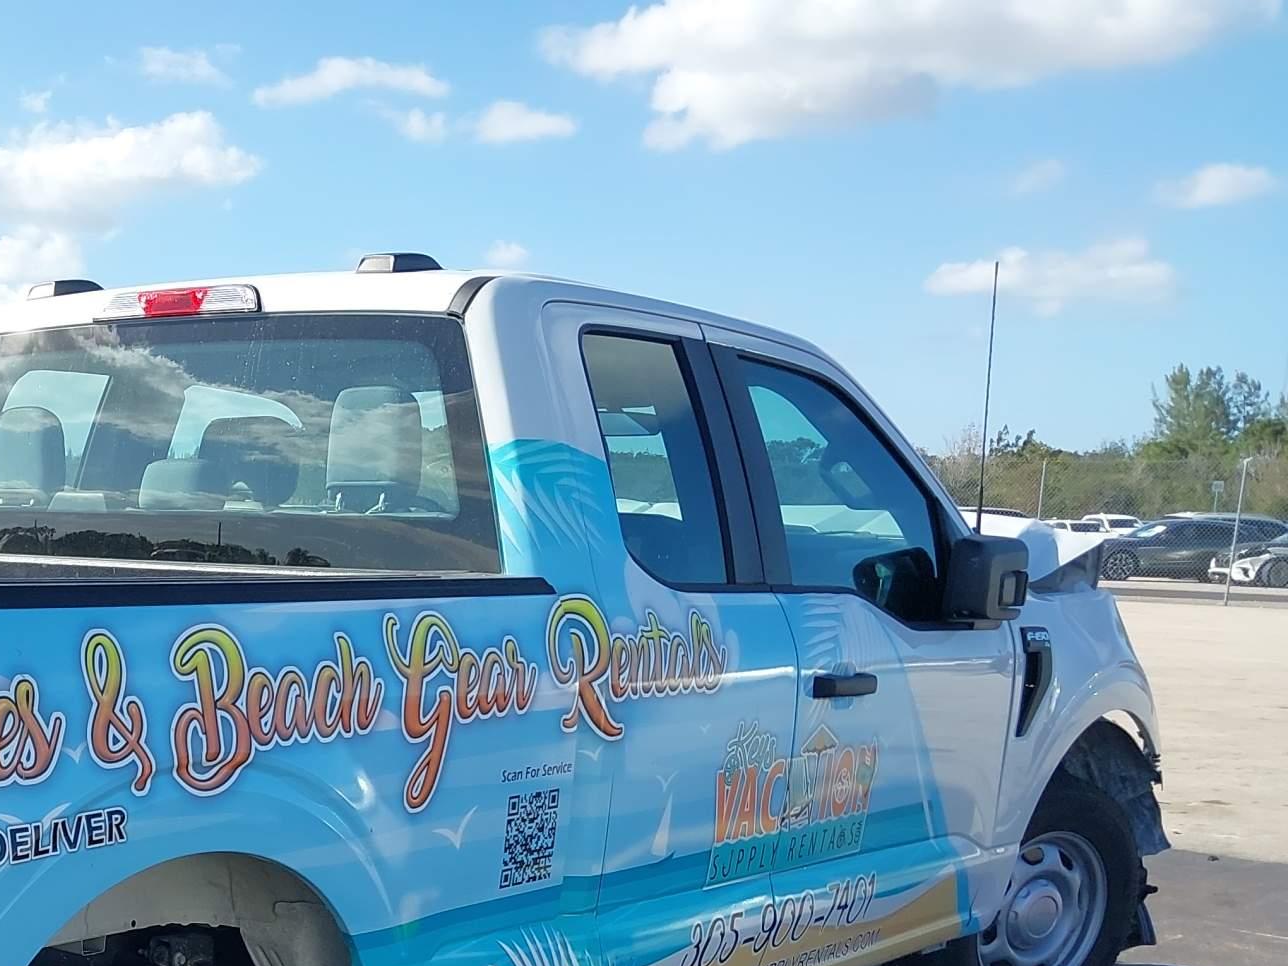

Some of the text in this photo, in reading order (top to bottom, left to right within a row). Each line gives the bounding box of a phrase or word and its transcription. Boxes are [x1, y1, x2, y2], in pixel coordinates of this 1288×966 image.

[79, 627, 156, 797] &
[167, 622, 386, 797] Beach
[383, 608, 537, 815] Gear
[545, 592, 729, 742] Rentals
[725, 720, 777, 773] Keys
[500, 760, 574, 784] Scan For Service
[708, 838, 783, 882] SUPPLY
